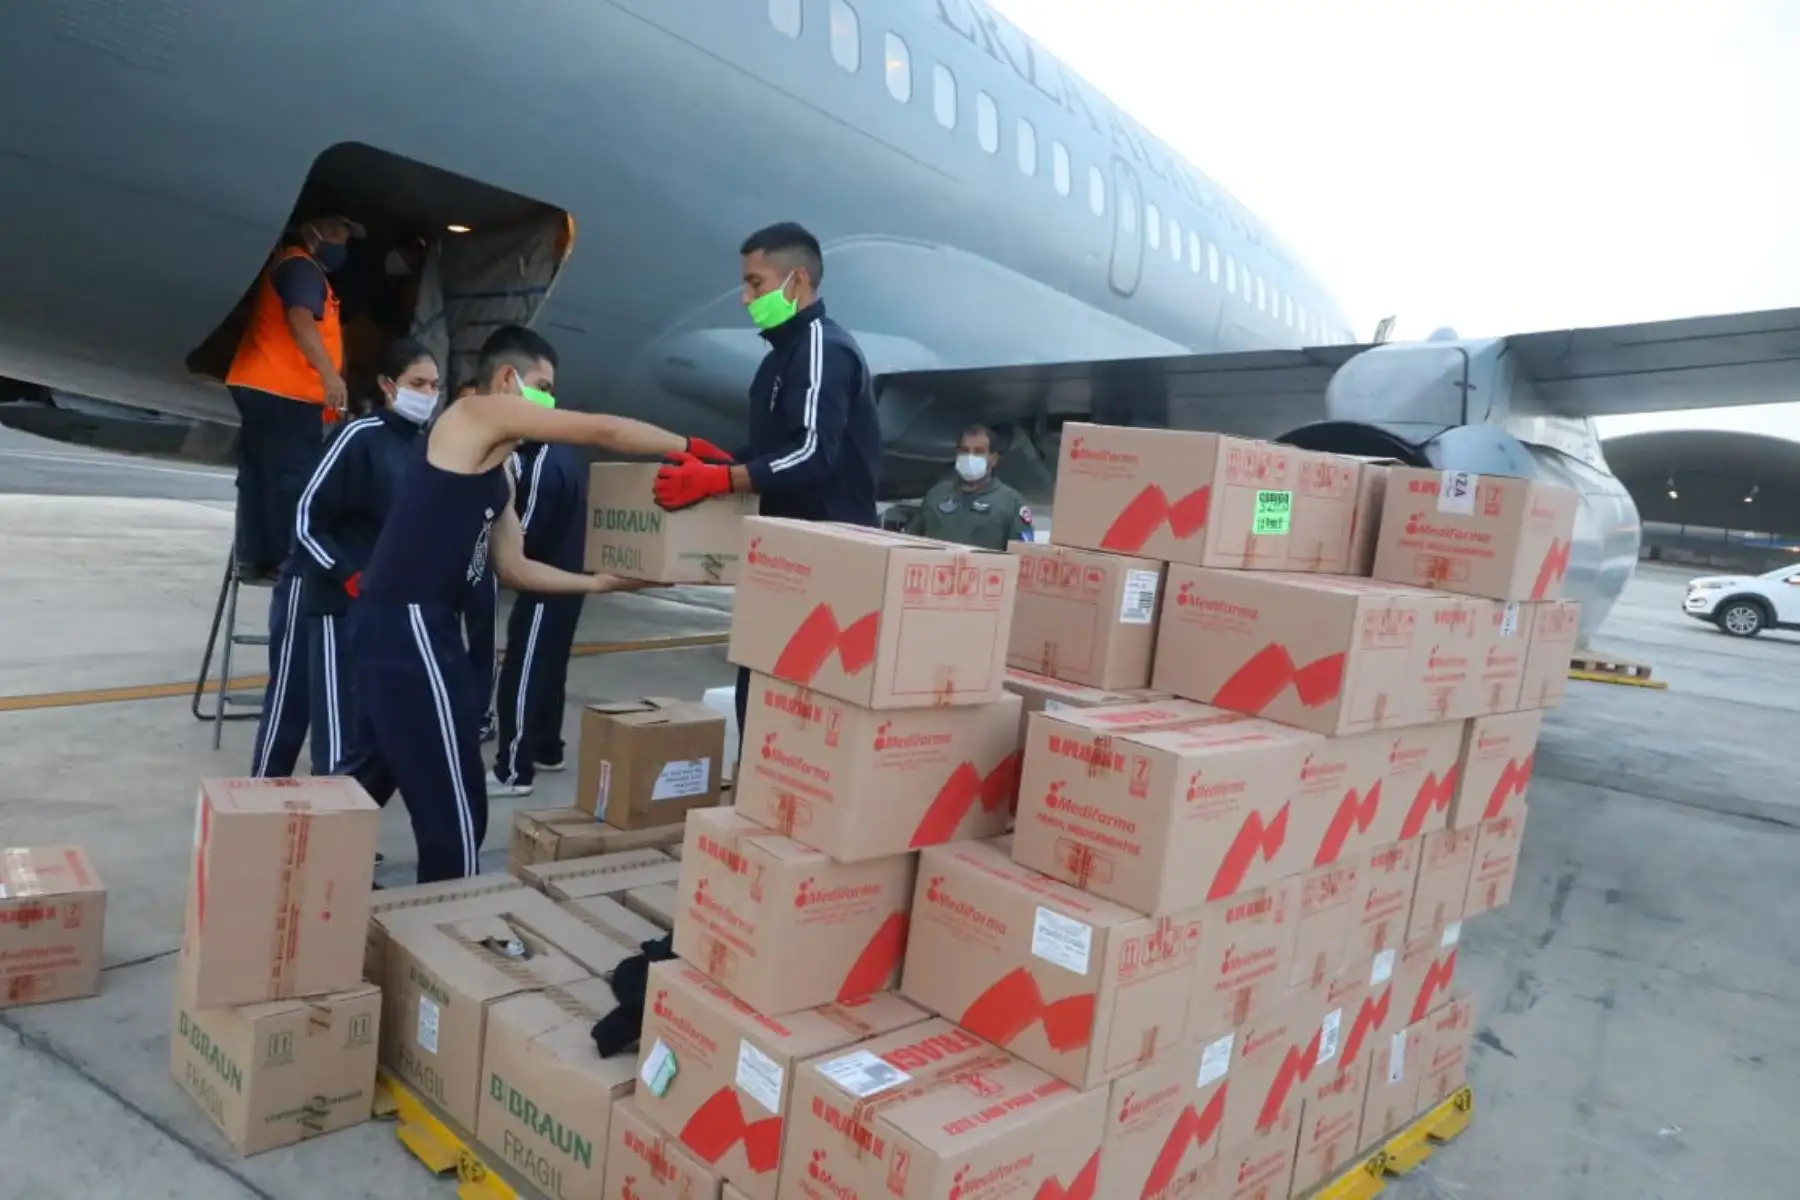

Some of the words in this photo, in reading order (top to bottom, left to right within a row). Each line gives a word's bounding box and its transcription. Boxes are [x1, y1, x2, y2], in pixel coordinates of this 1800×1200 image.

[601, 544, 643, 571] FRAGIL
[1056, 795, 1137, 836] Medifarma
[938, 893, 1008, 936] Medifarma
[401, 1046, 448, 1105] FRAGIL
[503, 1129, 571, 1200] FRAGIL
